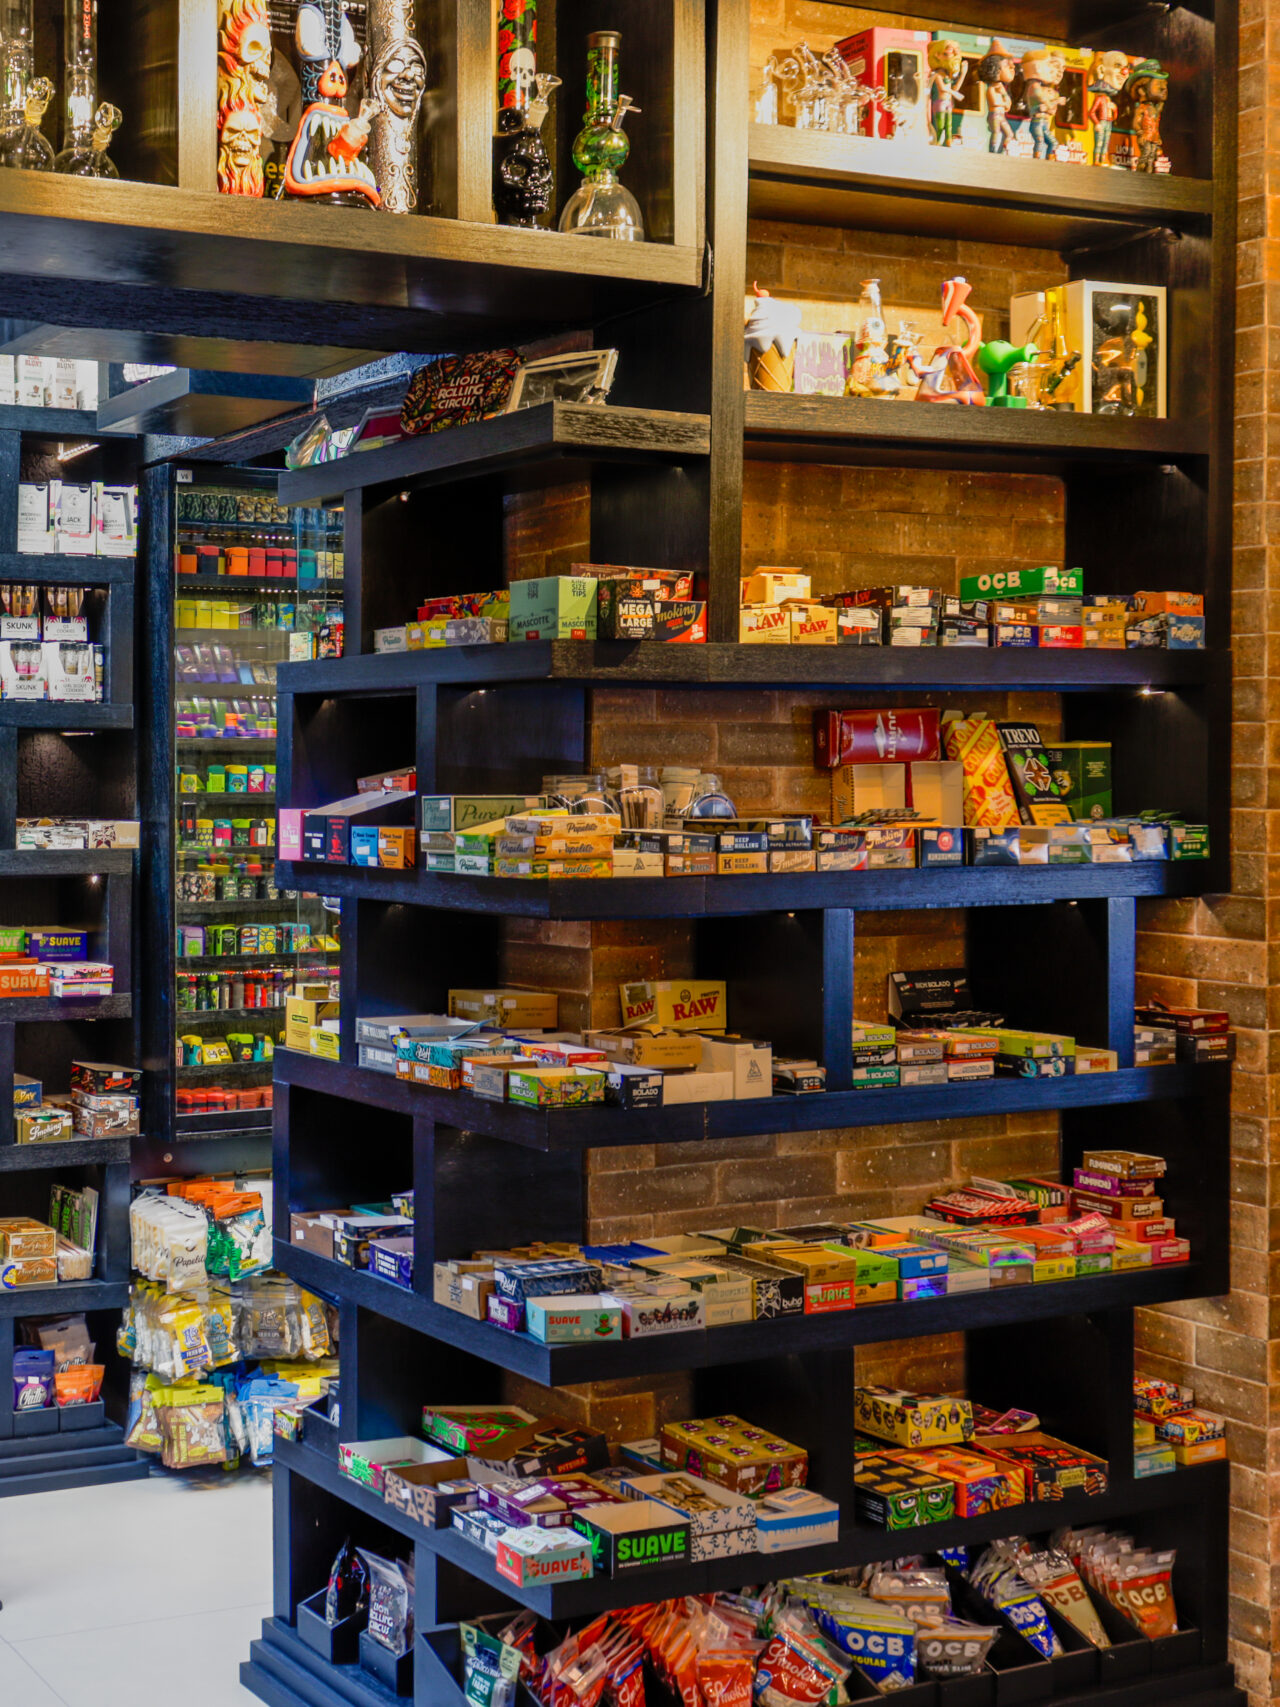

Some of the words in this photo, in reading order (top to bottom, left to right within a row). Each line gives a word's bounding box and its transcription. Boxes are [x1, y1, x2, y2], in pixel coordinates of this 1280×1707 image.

[449, 375, 481, 388] LION
[437, 383, 485, 398] ROLLING
[437, 396, 476, 410] CIRCUS
[977, 571, 1022, 592] OCB
[618, 604, 654, 617] MEGA
[6, 621, 32, 630] SKUNK
[516, 615, 550, 628] MASCOTTE
[620, 617, 654, 629] LARGE
[799, 619, 829, 635] RAW
[1005, 728, 1041, 745] TREVO
[48, 936, 82, 946] SUAVE
[0, 975, 48, 989] SUAVE
[626, 999, 656, 1020] RAW
[672, 996, 719, 1022] RAW
[632, 1088, 659, 1097] BOLADO
[28, 1124, 64, 1141] Smoking
[548, 1315, 582, 1326] SUAVE
[557, 1456, 588, 1474] PITEIRA
[616, 1529, 687, 1561] SUAVE
[534, 1556, 581, 1577] SUAVE
[1129, 1583, 1168, 1604] OCB
[1009, 1601, 1047, 1625] OCB
[846, 1630, 904, 1656] OCB
[926, 1639, 982, 1658] OCB
[761, 1642, 833, 1697] Smoking
